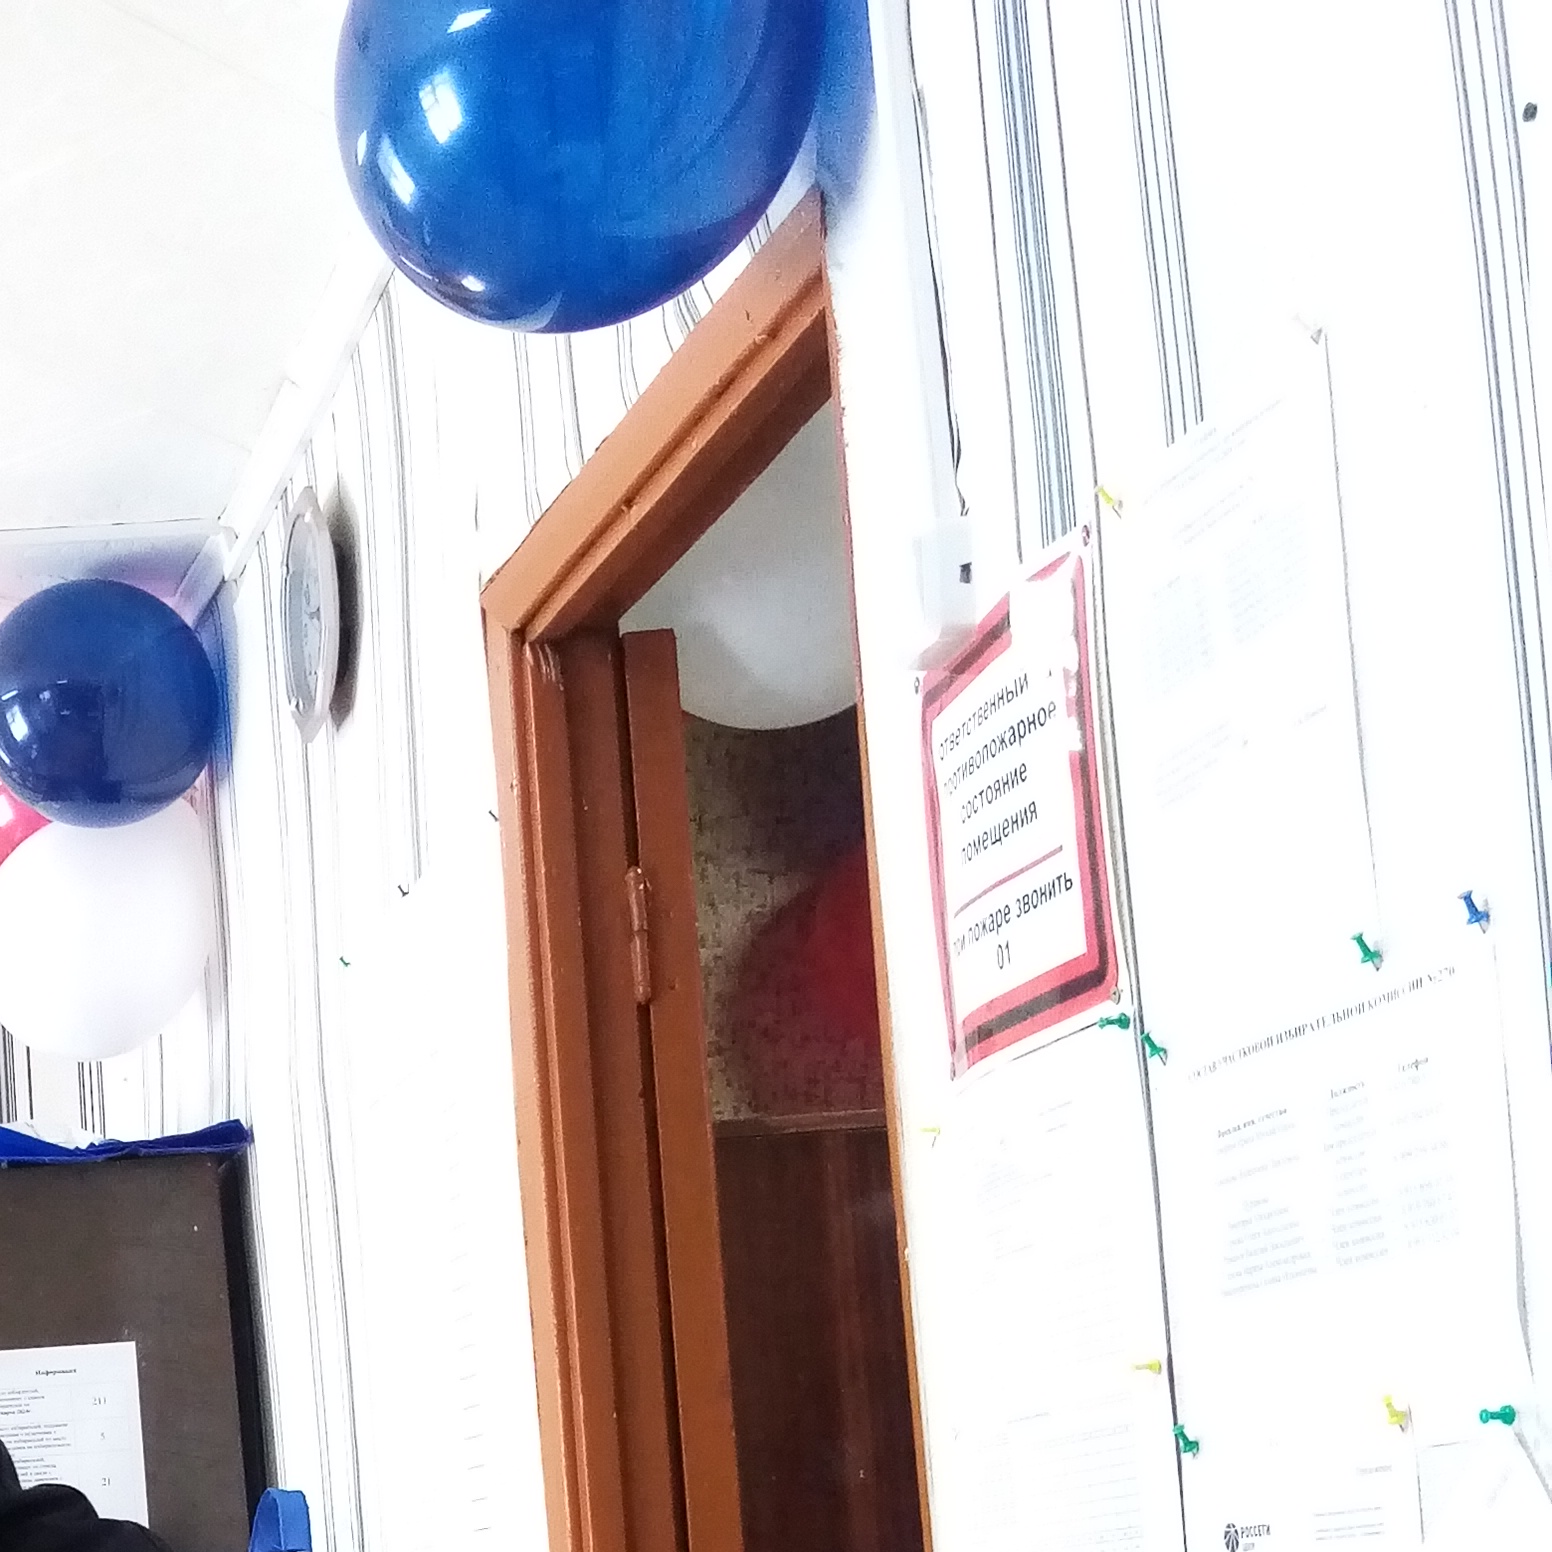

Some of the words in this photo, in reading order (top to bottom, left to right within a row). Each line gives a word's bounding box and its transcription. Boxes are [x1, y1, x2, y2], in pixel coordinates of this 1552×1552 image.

[939, 671, 1029, 761] ответственный
[944, 699, 1057, 798] противопожарное
[960, 762, 1028, 824] состояние
[960, 801, 1039, 866] помещения
[968, 903, 1012, 947] пожаре
[1015, 871, 1074, 918] звонить
[996, 939, 1012, 971] 01
[1240, 1523, 1271, 1539] РОССЕТИ
